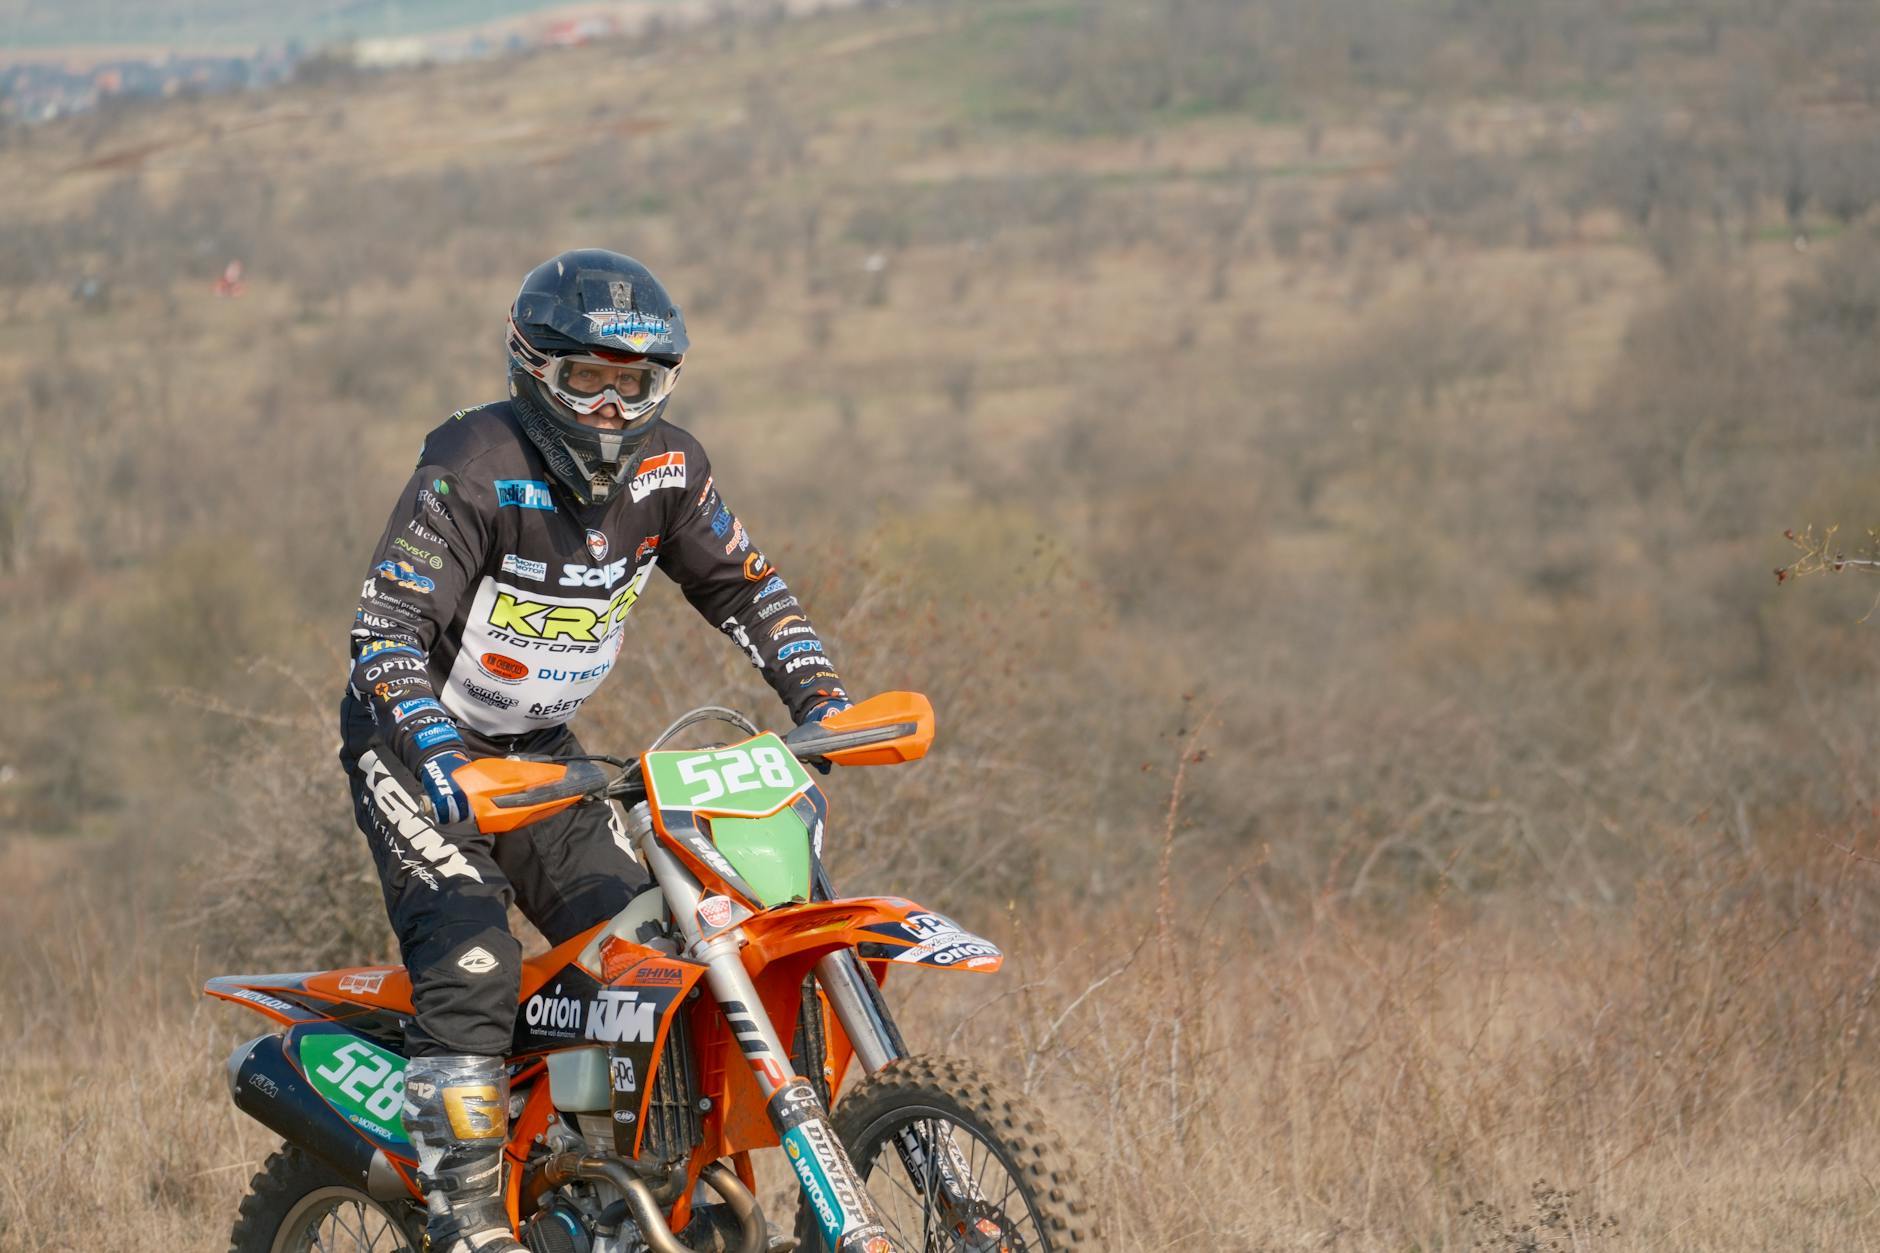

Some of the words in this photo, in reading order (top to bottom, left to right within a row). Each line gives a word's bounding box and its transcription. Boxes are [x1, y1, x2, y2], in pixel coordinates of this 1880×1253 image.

[462, 678, 519, 708] bambas
[538, 659, 610, 683] DUTECH
[676, 746, 795, 805] 528
[585, 991, 656, 1042] KTM
[316, 1042, 405, 1121] 528
[359, 1117, 392, 1140] MOTOREX
[796, 1157, 840, 1231] MOTOREX
